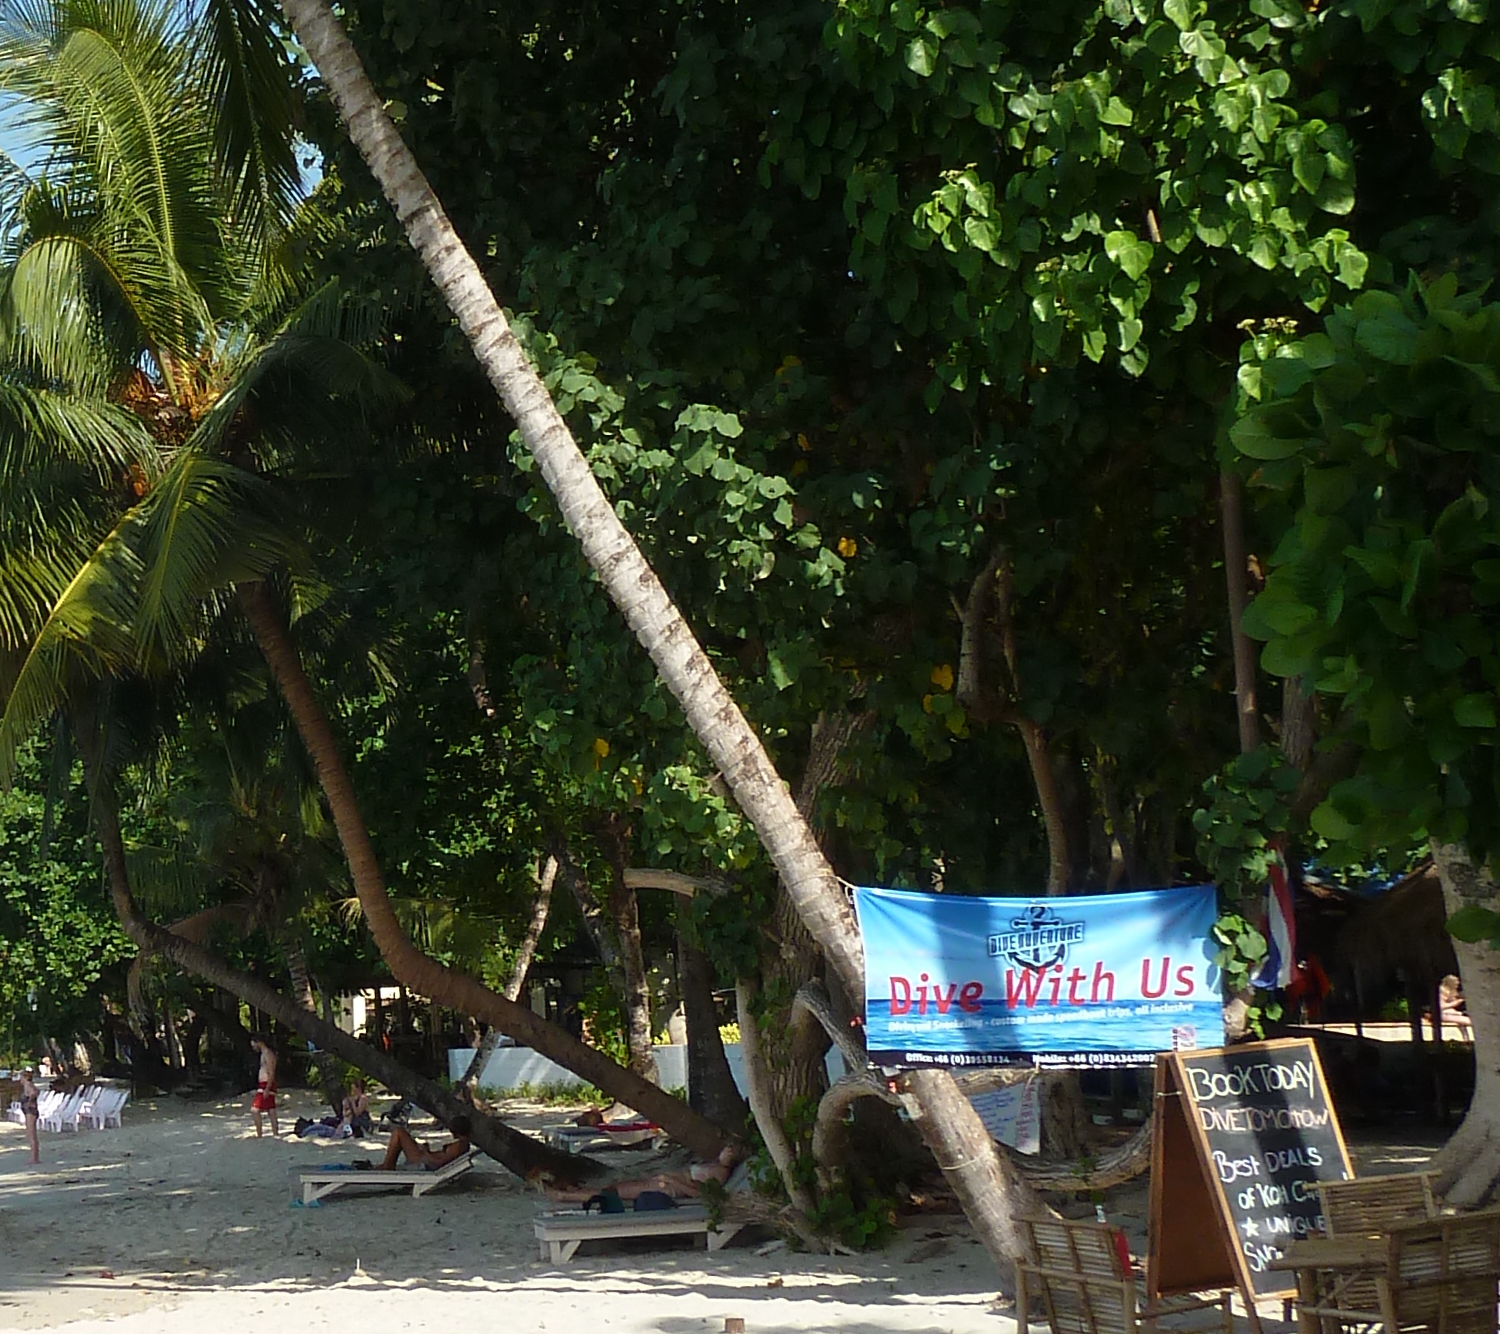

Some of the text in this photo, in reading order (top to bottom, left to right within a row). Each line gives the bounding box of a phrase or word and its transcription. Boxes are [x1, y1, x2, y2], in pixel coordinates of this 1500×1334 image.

[990, 934, 1016, 954] DIVE
[889, 956, 1196, 1016] Dive With Us
[1212, 1147, 1323, 1183] Best DEALS
